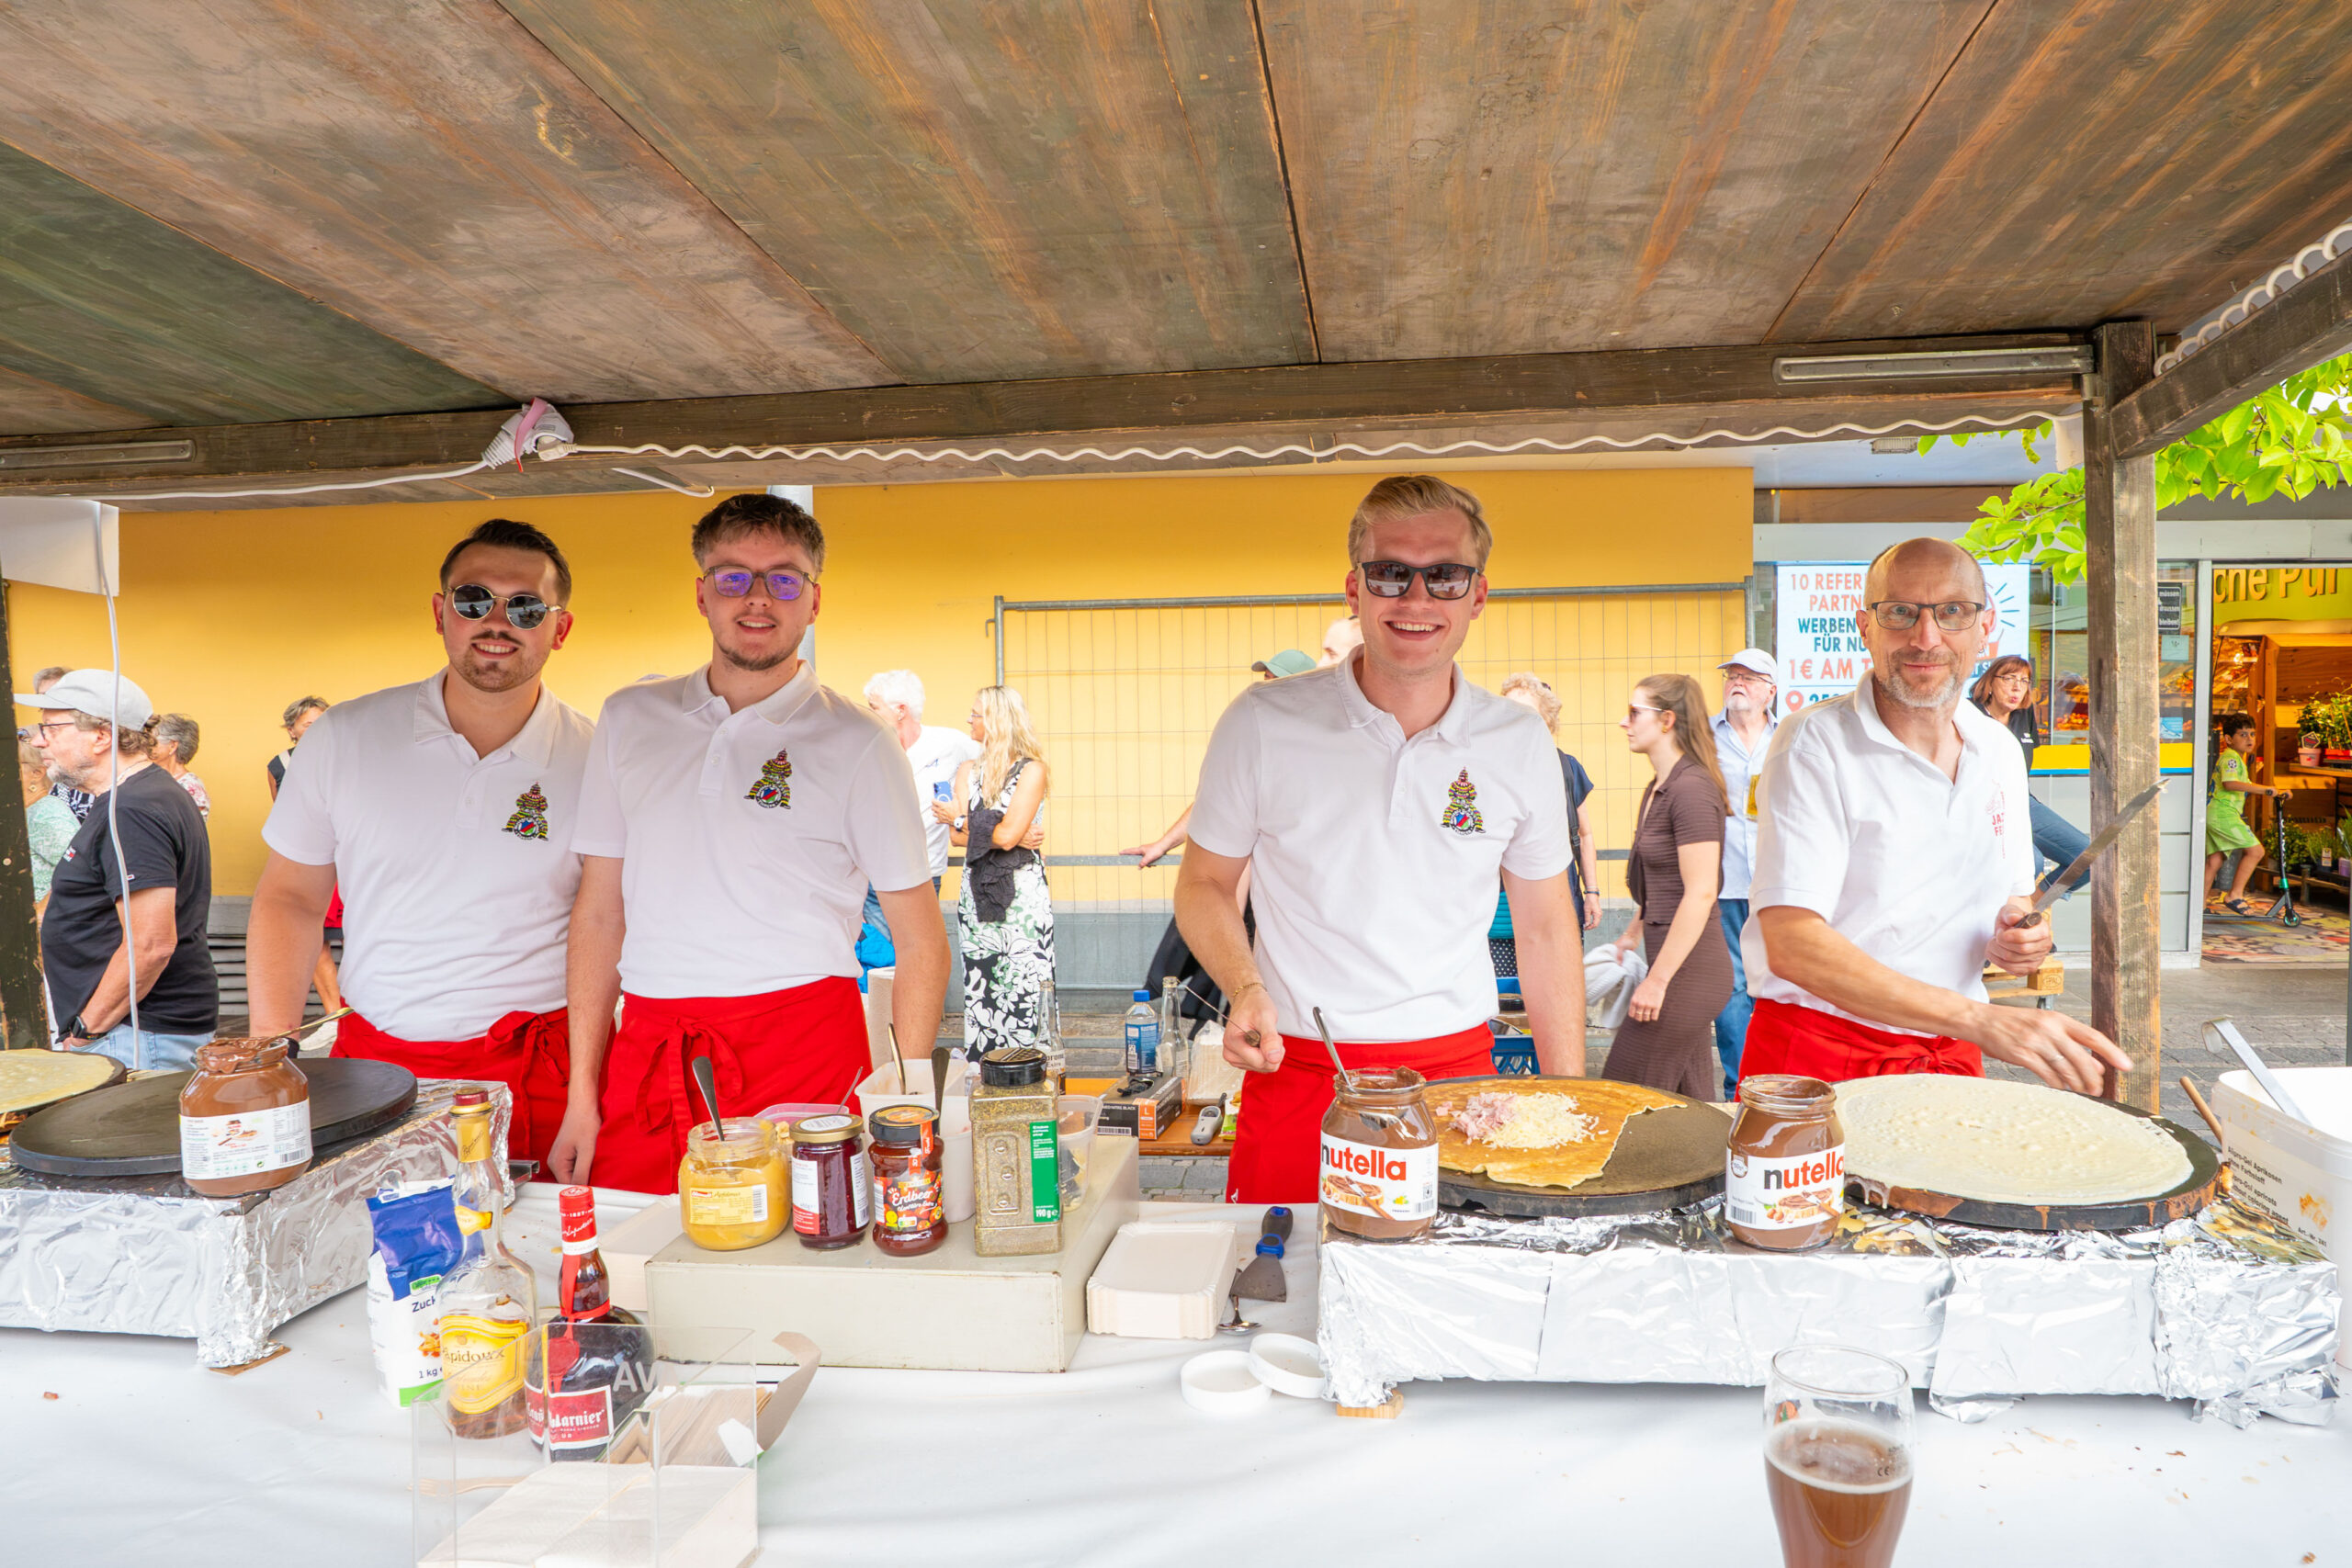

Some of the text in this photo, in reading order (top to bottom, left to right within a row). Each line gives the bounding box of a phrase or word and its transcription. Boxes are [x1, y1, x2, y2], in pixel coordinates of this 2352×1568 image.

[1791, 572, 1867, 591] 10 REFER
[1809, 594, 1866, 612] PARTN
[1798, 617, 1856, 634] WERBEN
[1814, 633, 1841, 652] FÜR
[1789, 659, 1813, 680] 1€
[1820, 658, 1854, 680] AM
[1144, 1107, 1150, 1115] L
[1322, 1143, 1407, 1182] nutella
[891, 1189, 934, 1207] Erdbeer
[426, 1367, 438, 1378] kg
